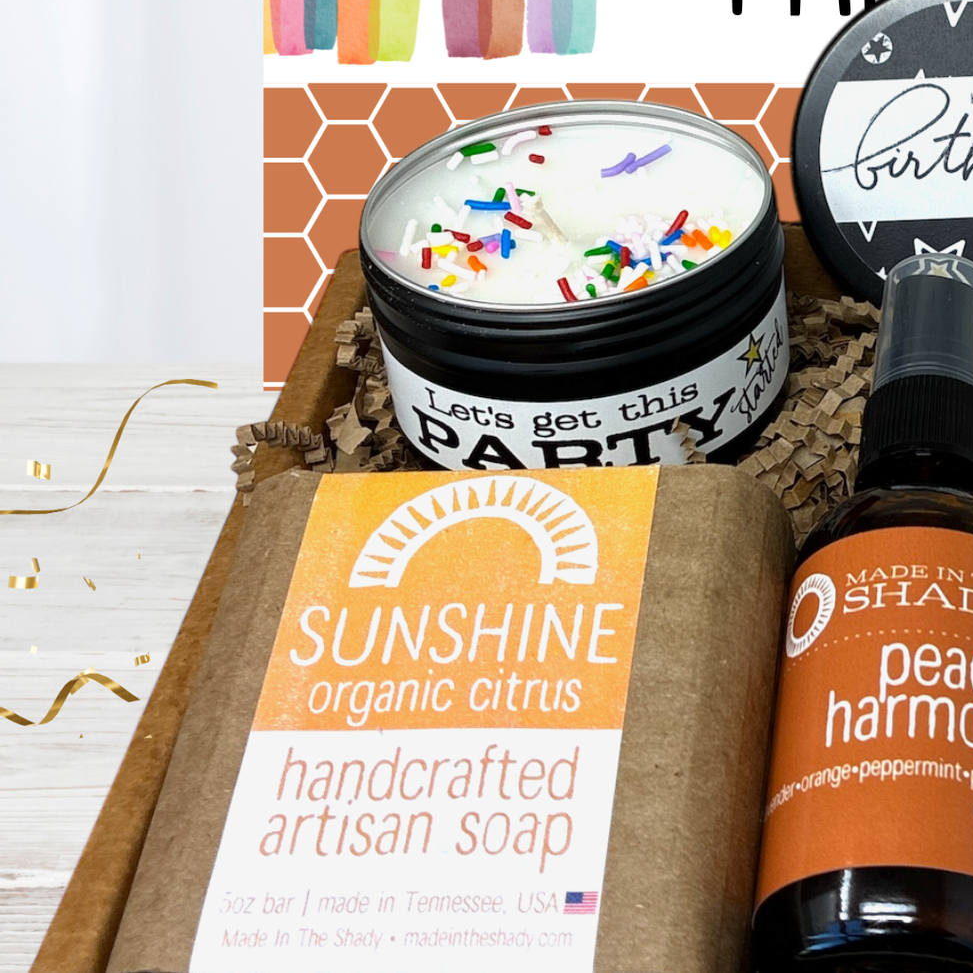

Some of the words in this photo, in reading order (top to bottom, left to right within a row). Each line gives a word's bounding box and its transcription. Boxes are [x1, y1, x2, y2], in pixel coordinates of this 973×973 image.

[730, 317, 783, 424] started
[411, 387, 736, 471] PARTY
[425, 387, 514, 429] Let's
[533, 411, 602, 438] get
[619, 382, 699, 422] this
[845, 565, 928, 586] MADE
[937, 566, 964, 583] IN
[289, 603, 624, 664] SUNSHINE
[308, 670, 454, 725] organic
[469, 669, 582, 712] citrus
[276, 744, 580, 802] handcrafted
[258, 801, 432, 857] artisan
[455, 810, 573, 874] soap
[262, 891, 295, 915] bar
[317, 891, 369, 914] made
[377, 892, 396, 914] in
[518, 891, 558, 914] USA
[221, 929, 268, 948] Made
[275, 930, 290, 947] In
[299, 928, 328, 948] The
[333, 928, 382, 951] Shady
[404, 928, 573, 951] madeintheshady.com
